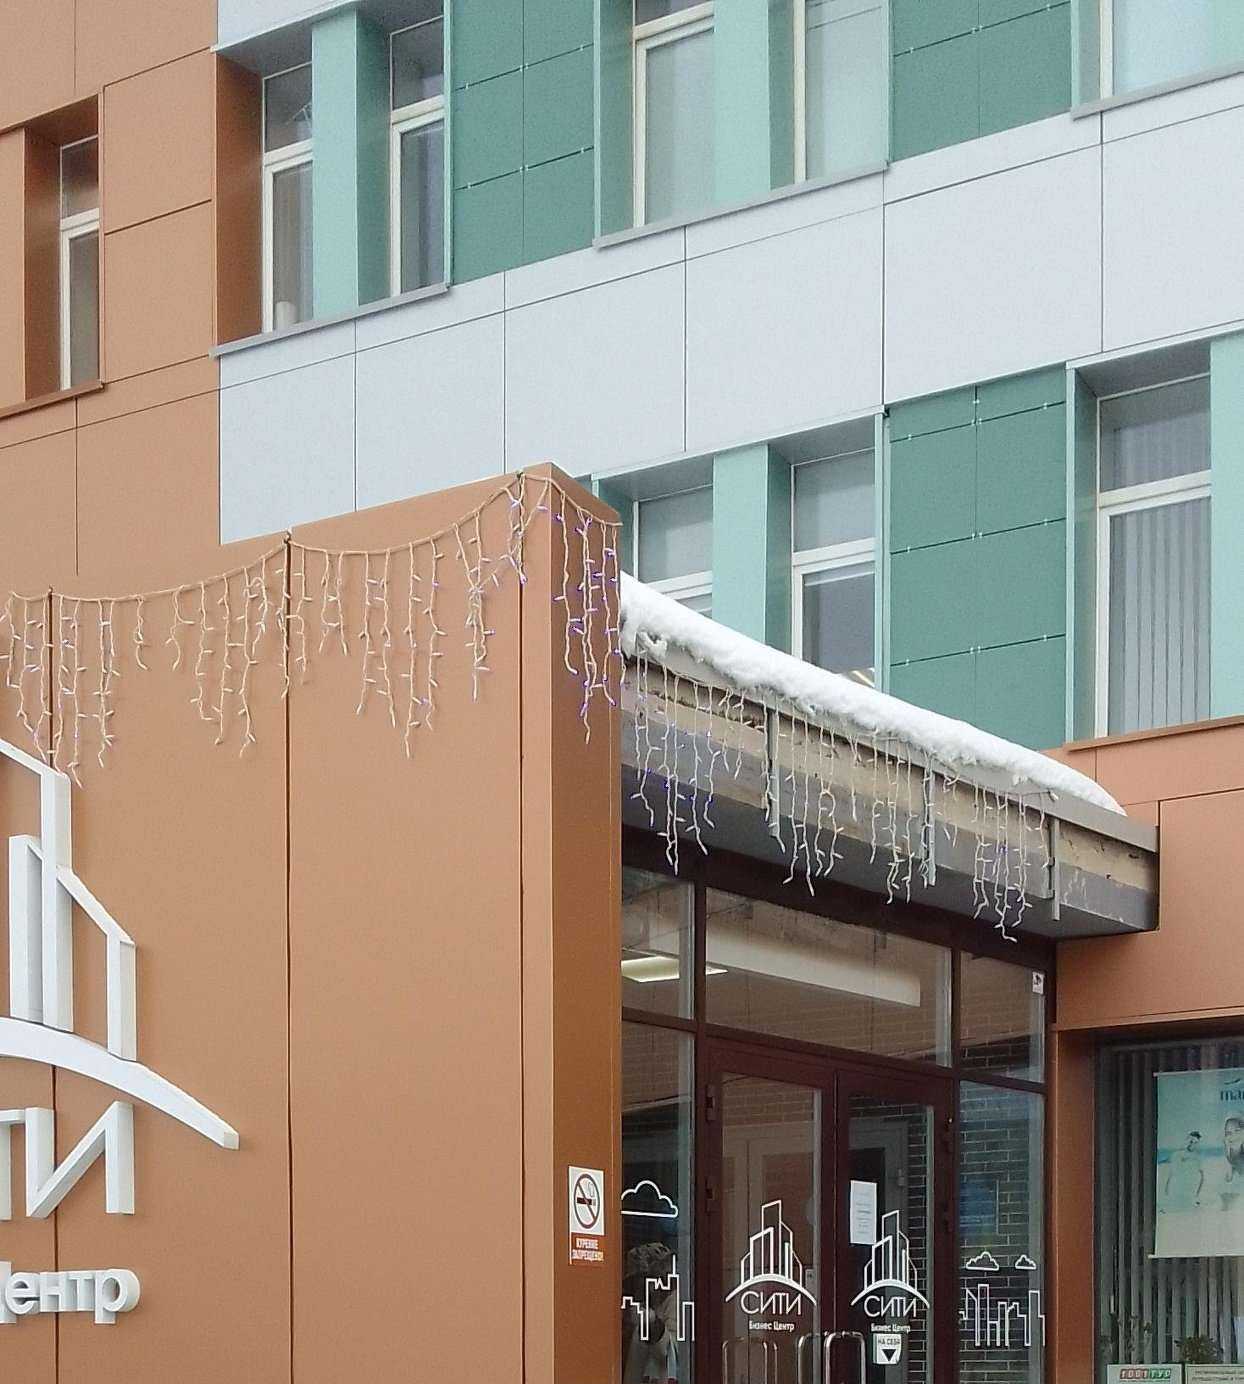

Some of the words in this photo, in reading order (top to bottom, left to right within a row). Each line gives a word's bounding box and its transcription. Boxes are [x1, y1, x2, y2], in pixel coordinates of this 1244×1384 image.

[740, 1291, 802, 1315] СИТИ
[864, 1295, 917, 1318] СИТИ
[749, 1320, 773, 1331] Бизнес
[773, 1320, 795, 1333] Центр
